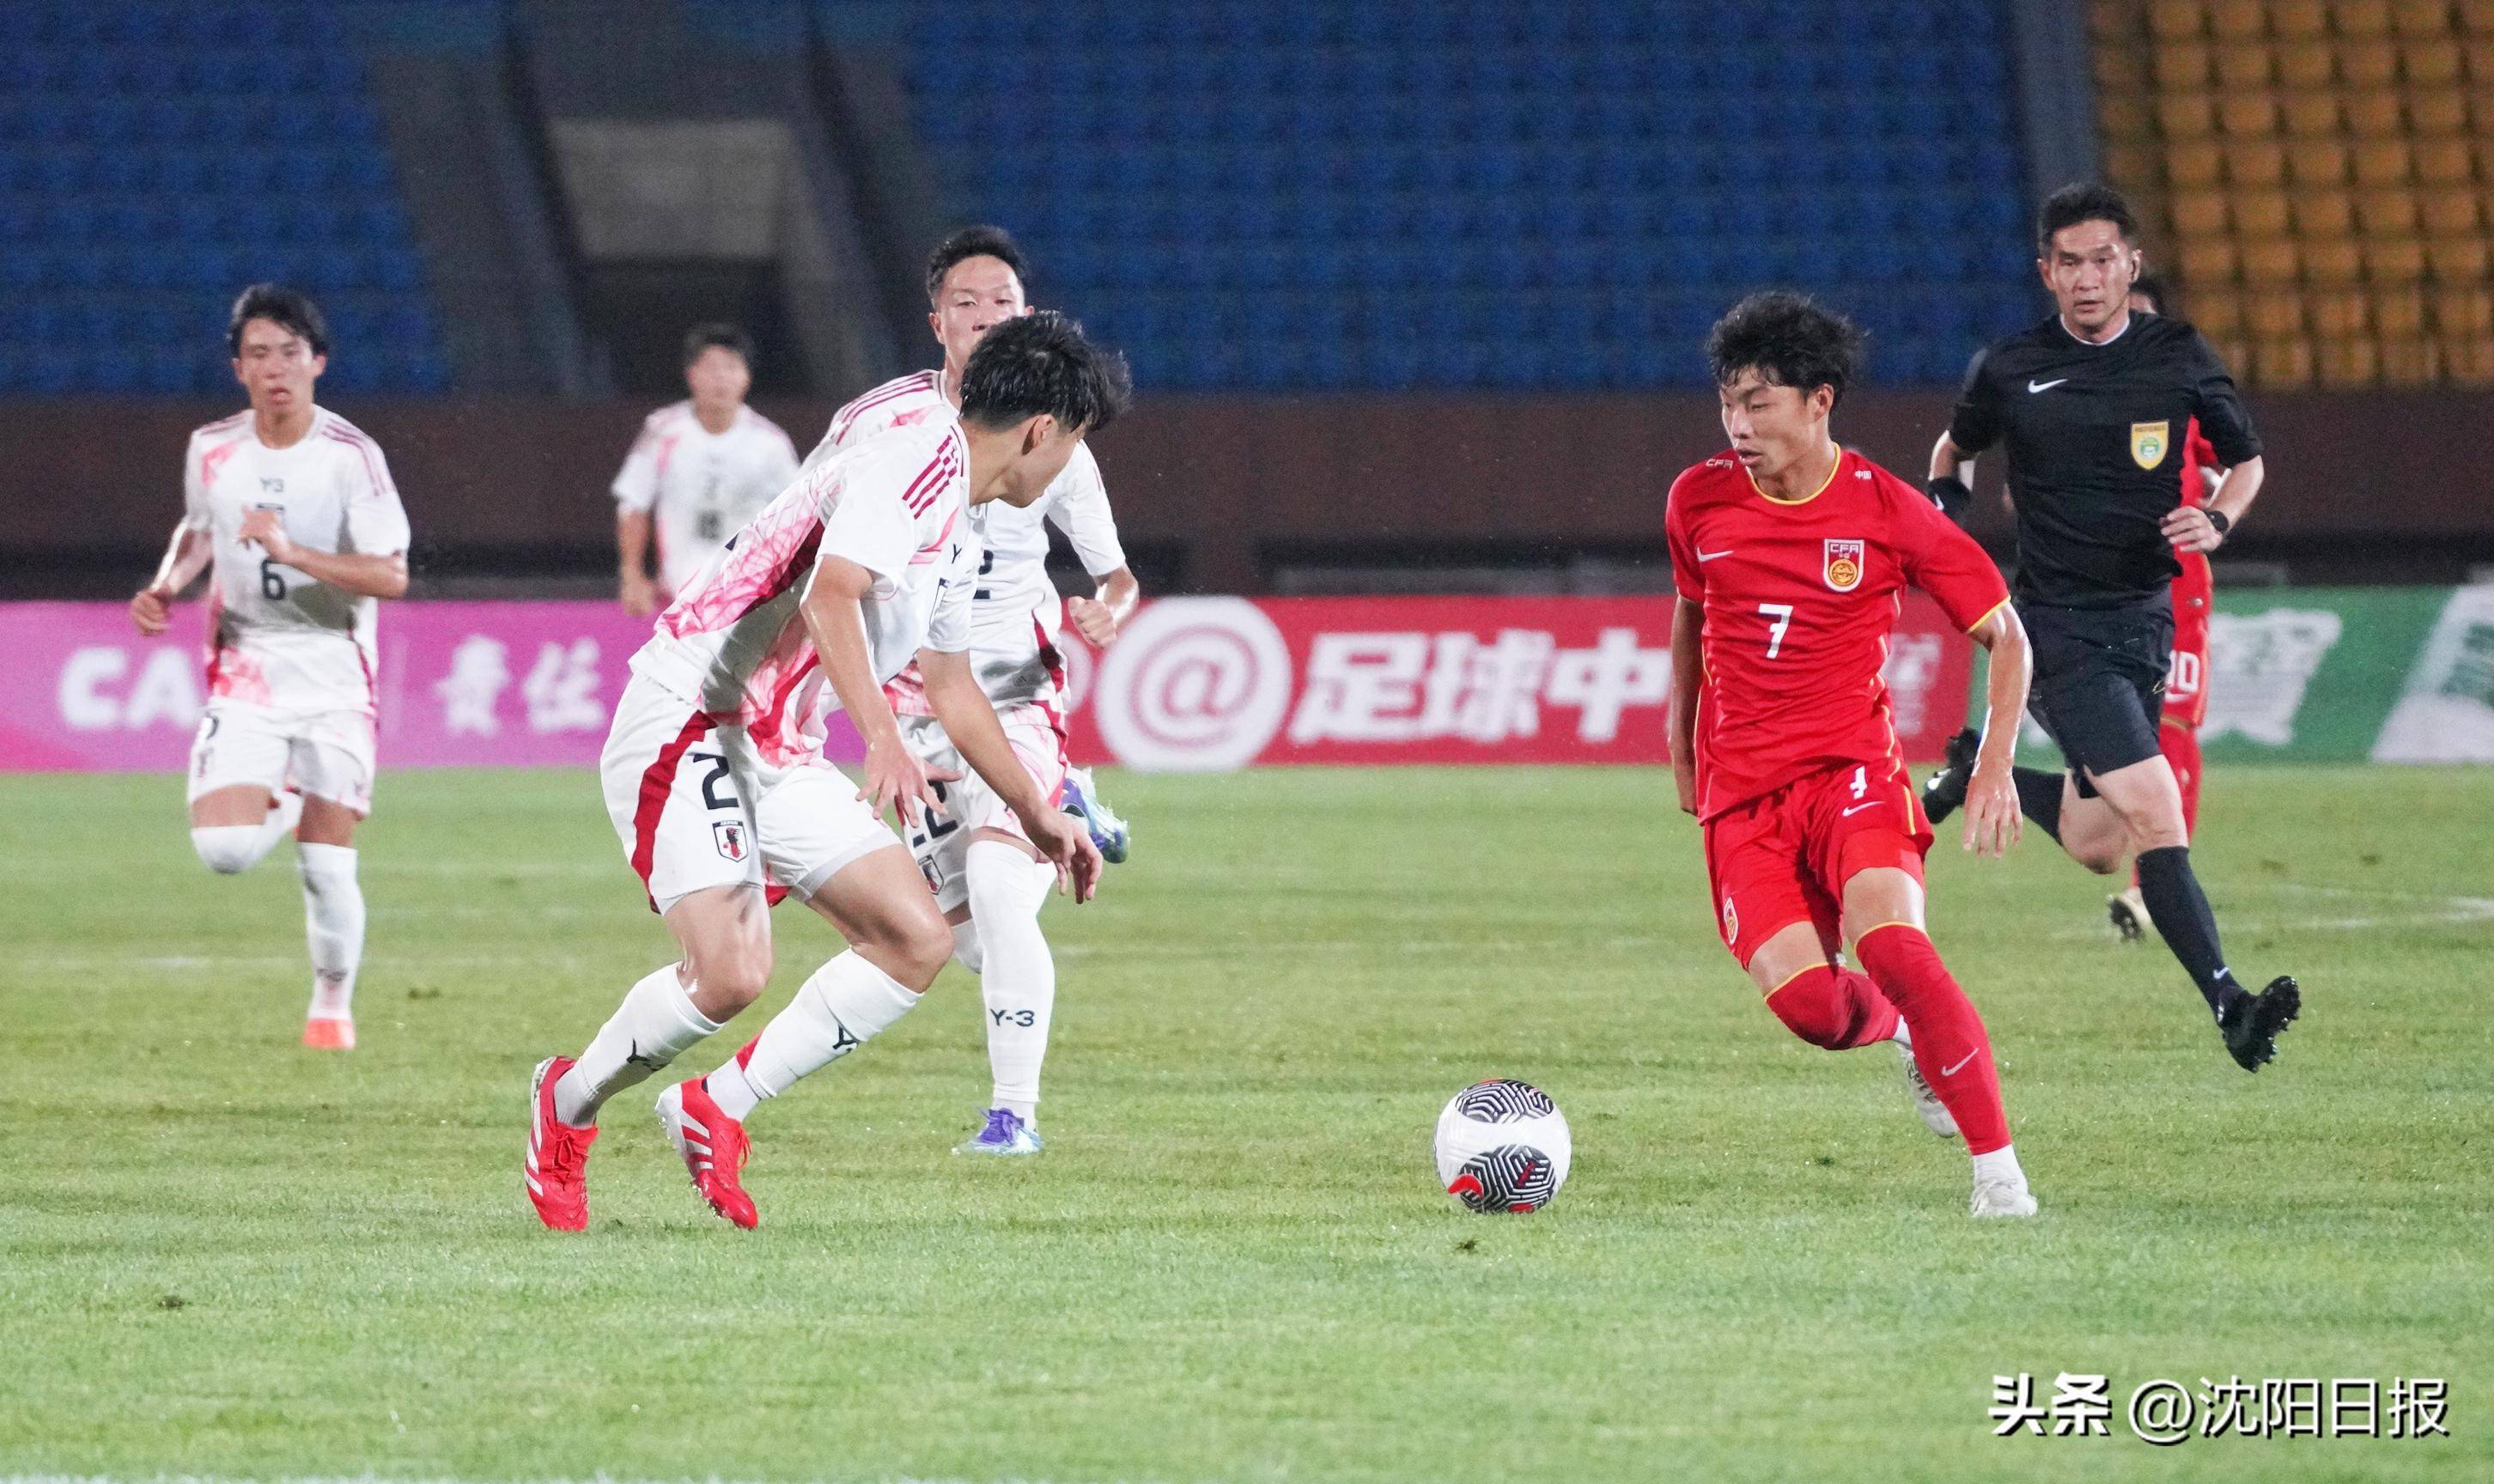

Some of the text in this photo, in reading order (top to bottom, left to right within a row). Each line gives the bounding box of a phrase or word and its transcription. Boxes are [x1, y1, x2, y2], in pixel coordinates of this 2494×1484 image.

[1706, 458, 1734, 469] CFA
[1829, 543, 1859, 554] CFA
[260, 557, 287, 601] 6
[1758, 603, 1794, 660] 7
[687, 752, 739, 811] 2
[989, 1007, 1036, 1028] Y-3
